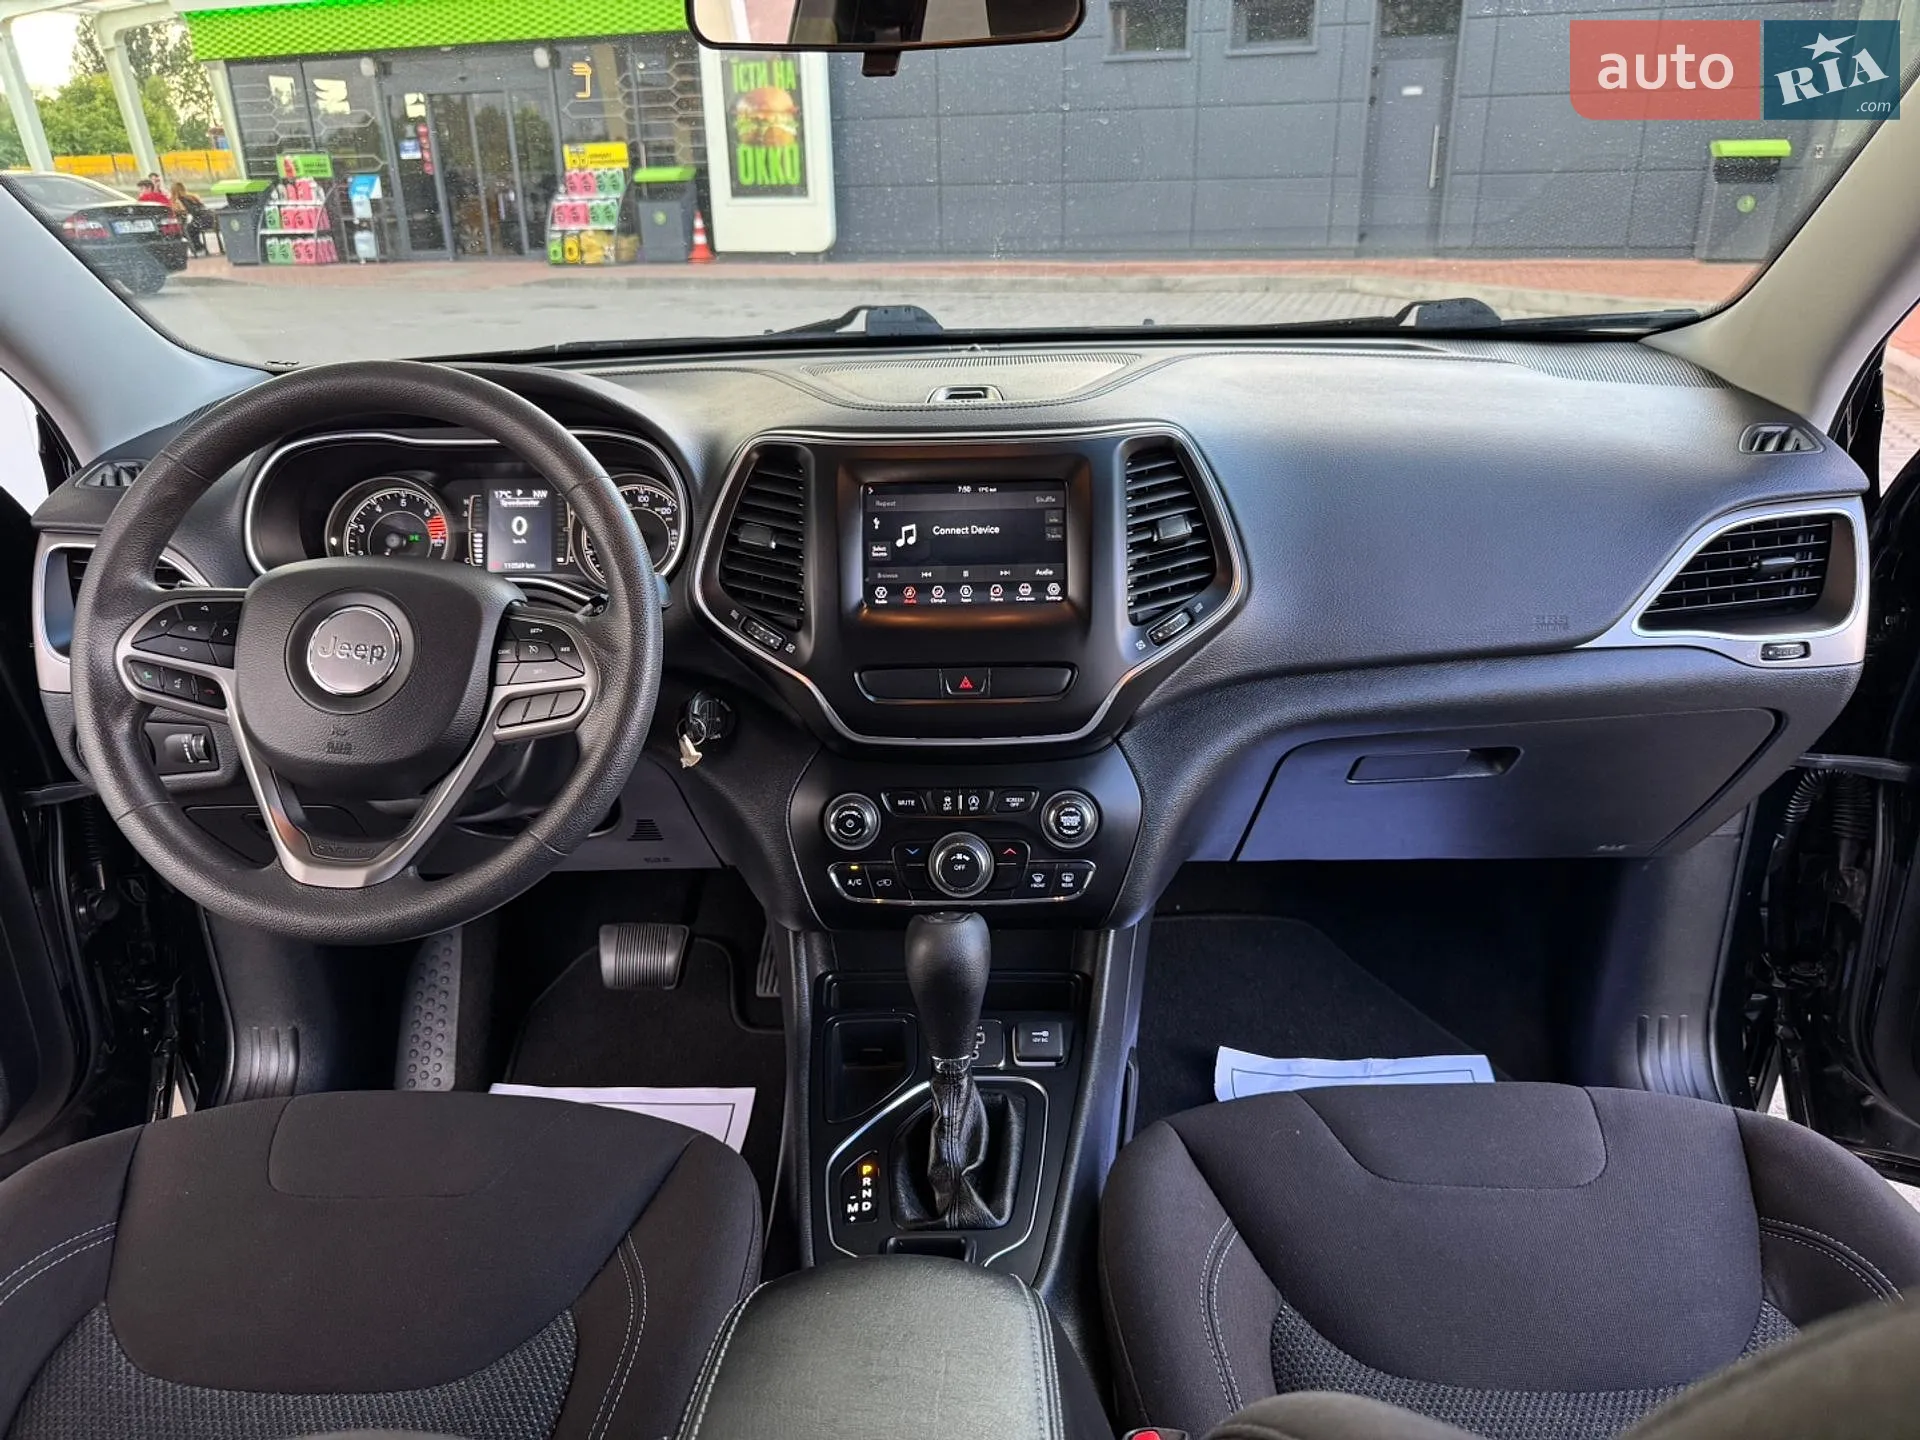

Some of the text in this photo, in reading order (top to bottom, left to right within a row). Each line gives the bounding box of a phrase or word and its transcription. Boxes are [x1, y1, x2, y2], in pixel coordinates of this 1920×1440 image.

[511, 516, 528, 536] 0
[932, 525, 1000, 535] Connect Device
[317, 635, 387, 664] Jeep
[847, 878, 862, 886] A/C
[862, 1165, 873, 1175] P
[862, 1177, 872, 1187] R
[862, 1188, 872, 1199] N
[847, 1202, 859, 1213] M
[861, 1201, 872, 1212] D
